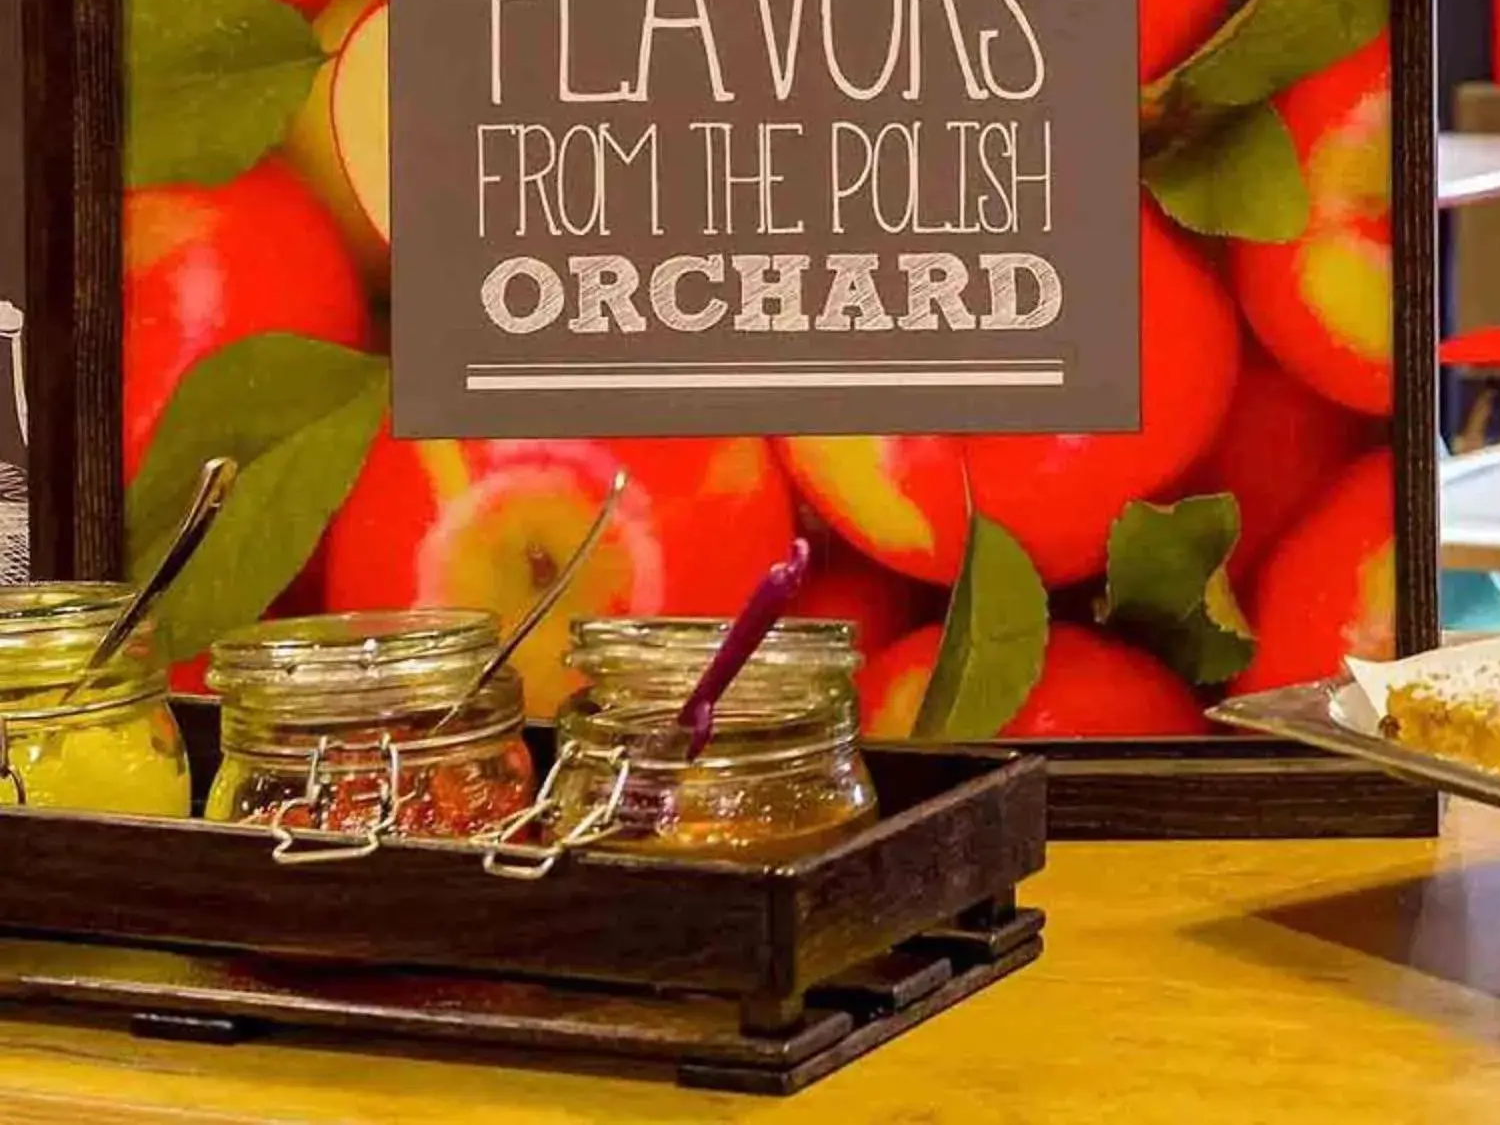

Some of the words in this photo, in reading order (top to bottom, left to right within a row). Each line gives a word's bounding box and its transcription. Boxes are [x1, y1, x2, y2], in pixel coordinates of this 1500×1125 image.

[477, 123, 664, 237] FROM
[689, 122, 804, 236] THE
[831, 121, 1051, 235] POLISH
[480, 252, 1062, 335] ORCHARD
